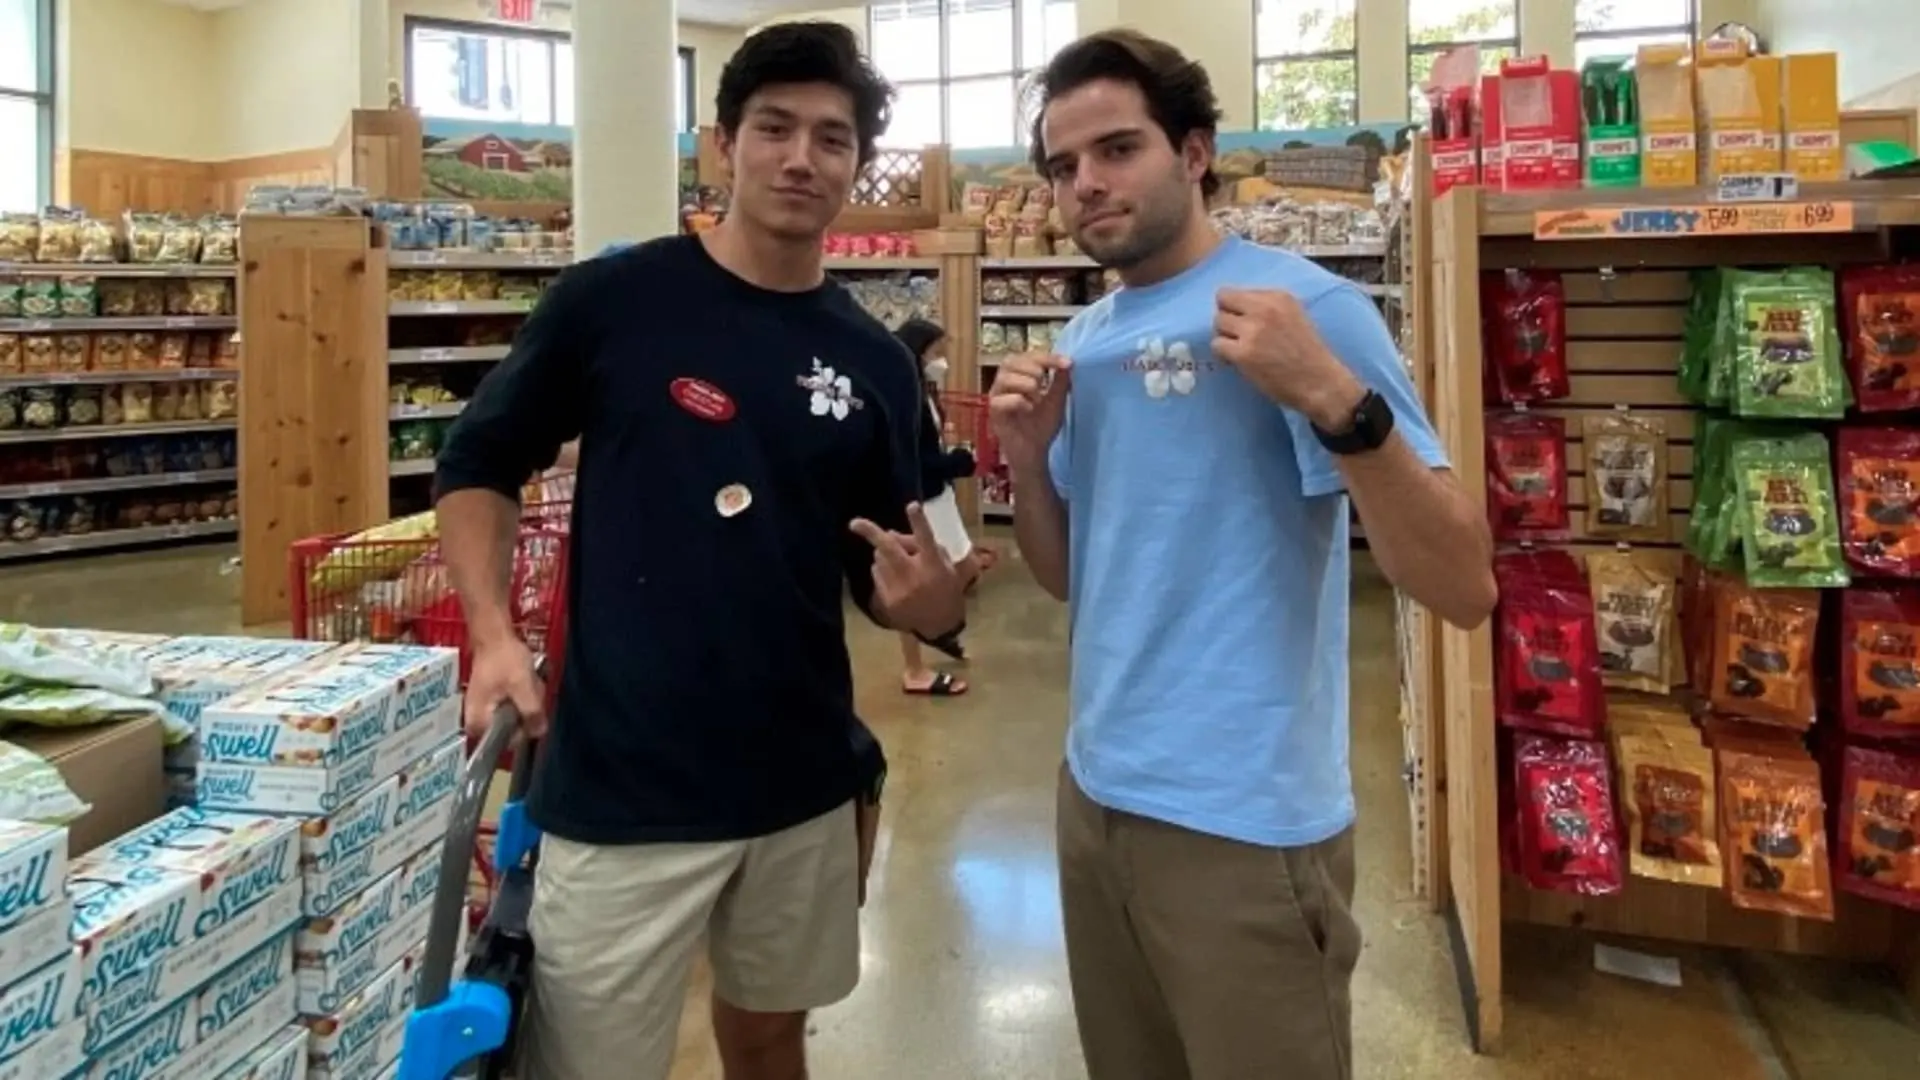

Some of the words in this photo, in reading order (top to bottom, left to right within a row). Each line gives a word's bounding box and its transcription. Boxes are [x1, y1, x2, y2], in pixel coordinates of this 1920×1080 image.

[500, 0, 533, 20] EXIT
[1650, 134, 1689, 149] CHOMPS
[1719, 132, 1757, 147] CHOMPS
[1611, 209, 1702, 233] JERKY
